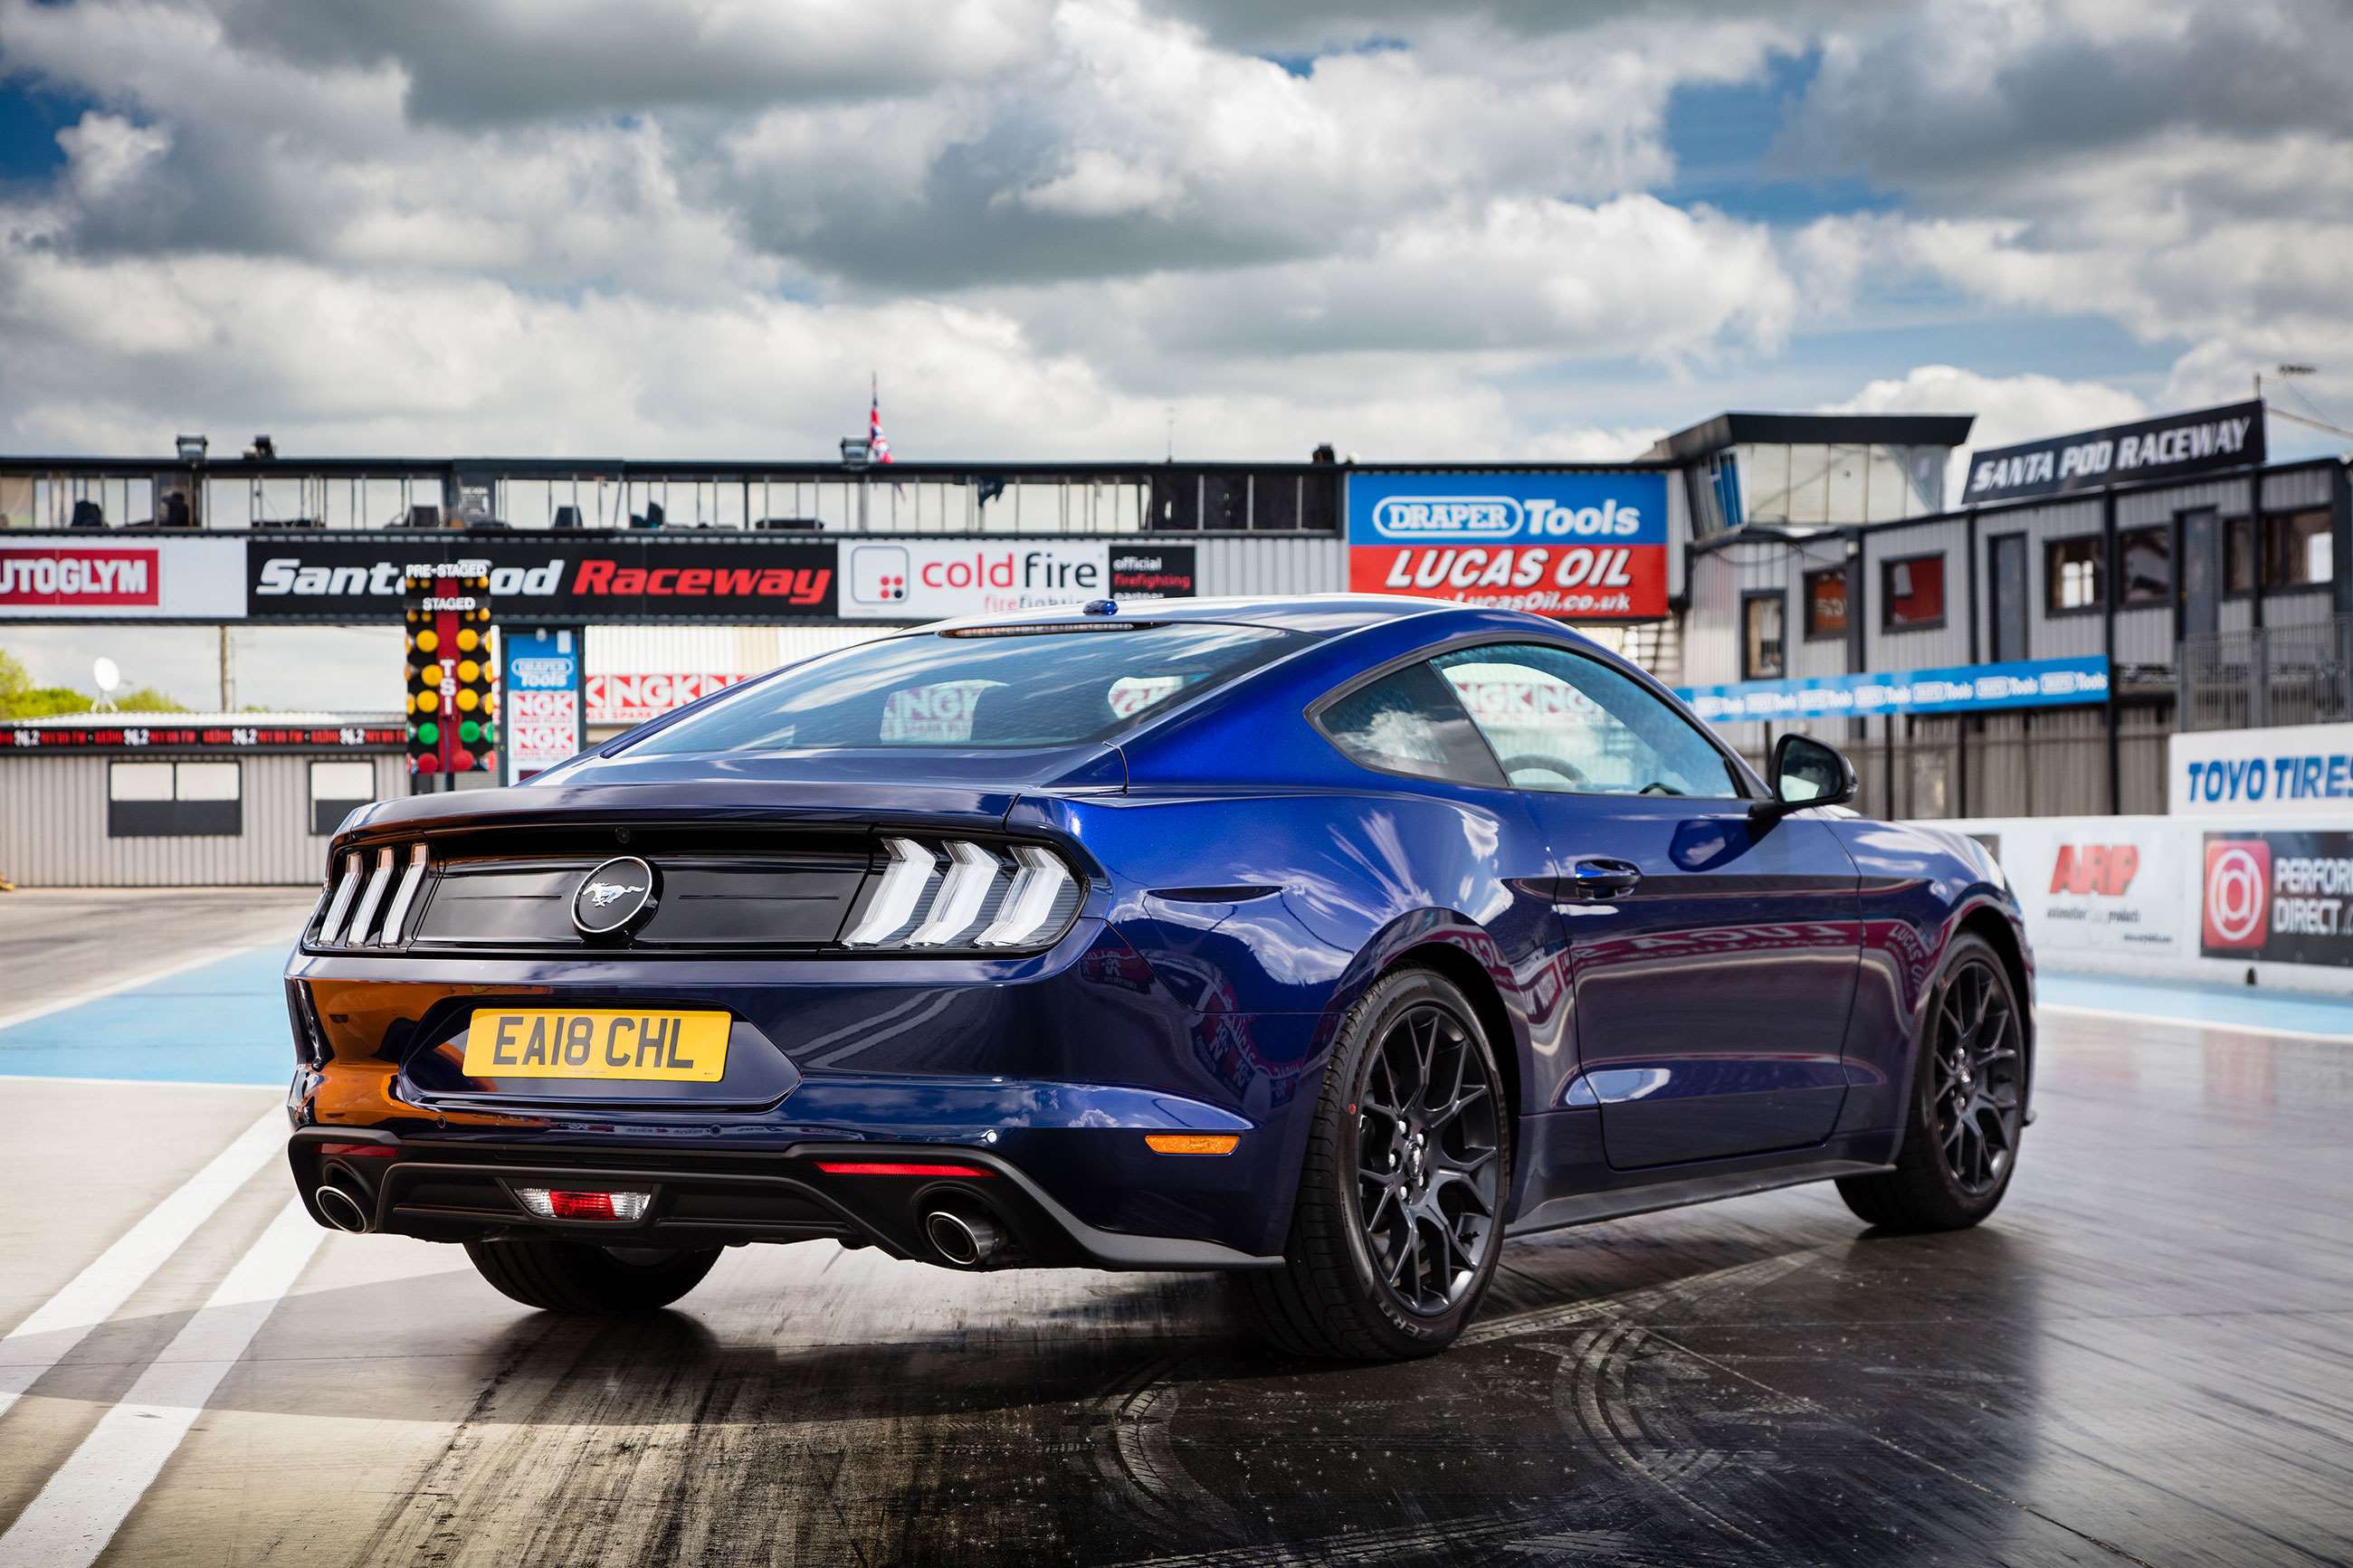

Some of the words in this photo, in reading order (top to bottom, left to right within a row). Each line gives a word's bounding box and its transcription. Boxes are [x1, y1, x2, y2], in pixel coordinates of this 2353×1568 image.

[1971, 451, 2054, 493] SANTA
[2058, 440, 2113, 480] POD
[2116, 416, 2252, 471] RACEWAY
[1387, 504, 1510, 529] DRAPER
[1524, 499, 1640, 535] Tools
[0, 557, 148, 594] UTOGLYM
[256, 558, 405, 595] Sant
[457, 558, 566, 595] od
[572, 559, 831, 604] Raceway
[405, 564, 488, 578] PRE-STAGED
[921, 552, 1015, 588] cold
[1024, 552, 1098, 588] fire
[1113, 556, 1162, 572] official
[1114, 573, 1190, 590] firefighting
[1386, 548, 1549, 588] LUCAS
[1554, 548, 1632, 588] OIL
[422, 597, 476, 611] STAGED
[513, 693, 573, 716] NGK
[611, 676, 702, 708] NGK
[513, 727, 573, 749] NGK
[2187, 758, 2267, 802] TOYO
[2049, 844, 2139, 897] ARP
[492, 1016, 594, 1066] EA18
[605, 1017, 694, 1069] CHL
